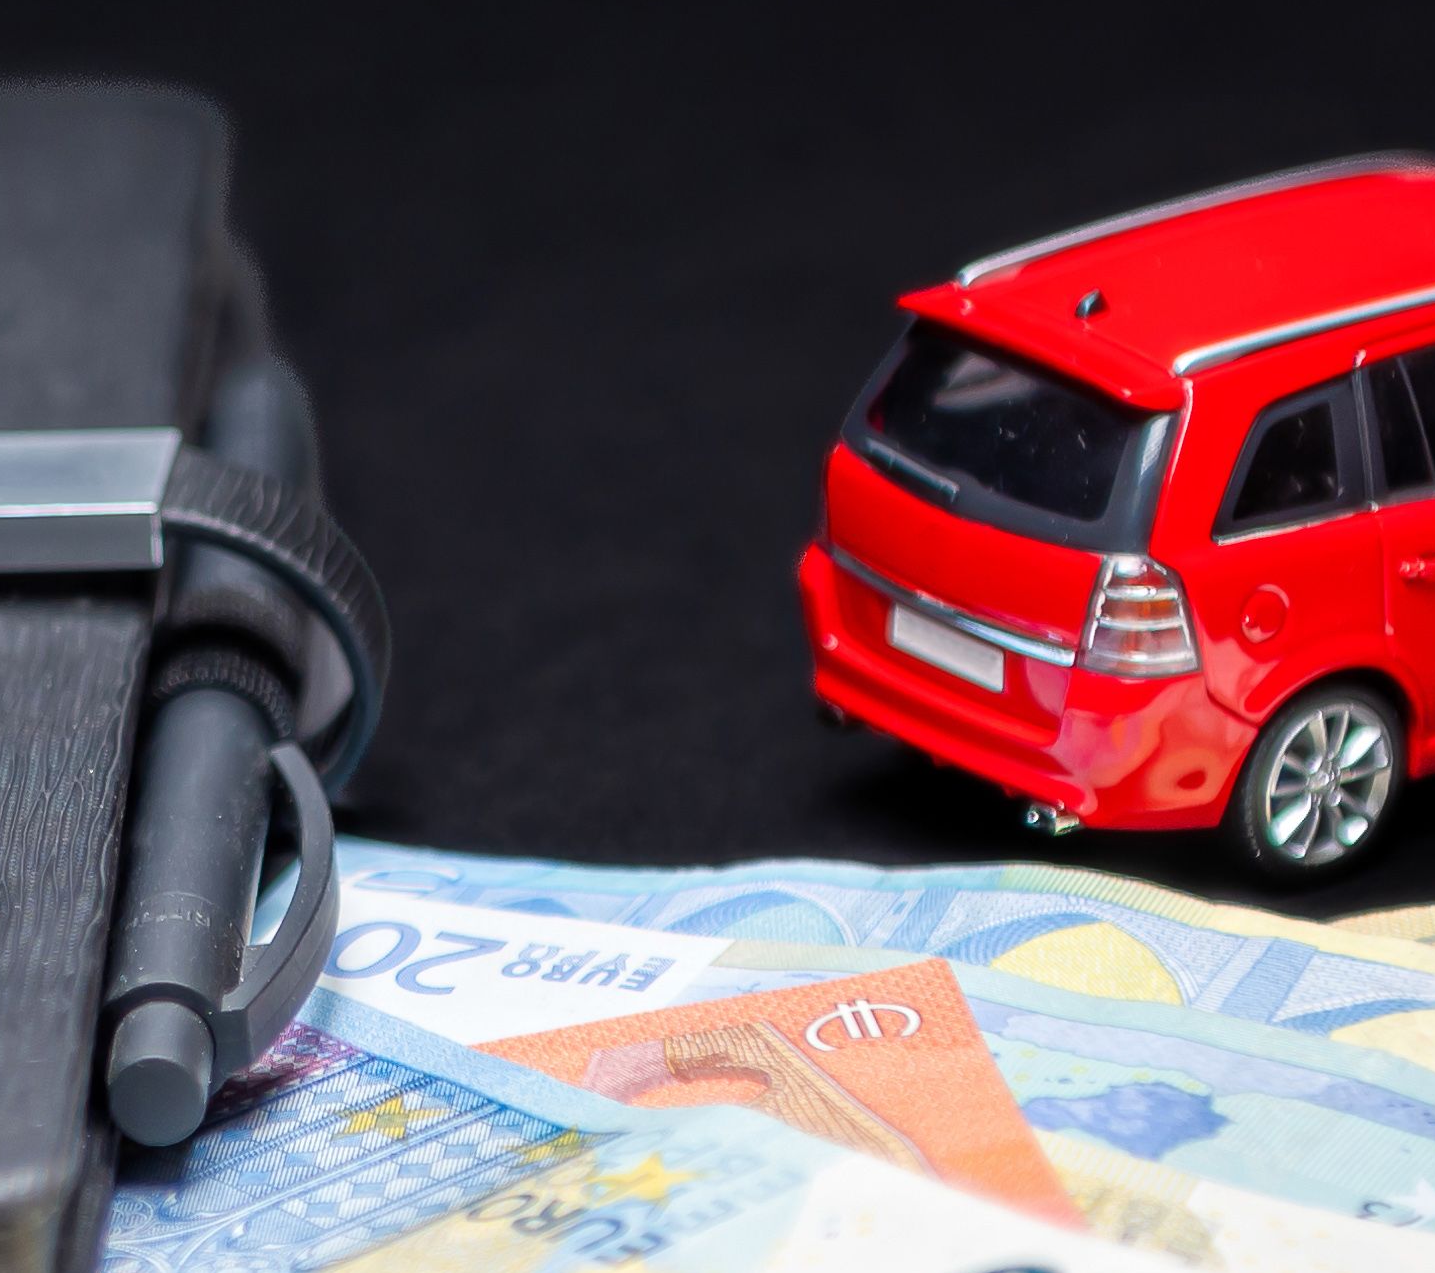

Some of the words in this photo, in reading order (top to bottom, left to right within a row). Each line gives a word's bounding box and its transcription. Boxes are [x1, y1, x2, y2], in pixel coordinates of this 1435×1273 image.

[325, 920, 508, 997] 20
[500, 958, 659, 994] EURO
[464, 1191, 676, 1271] EURO
